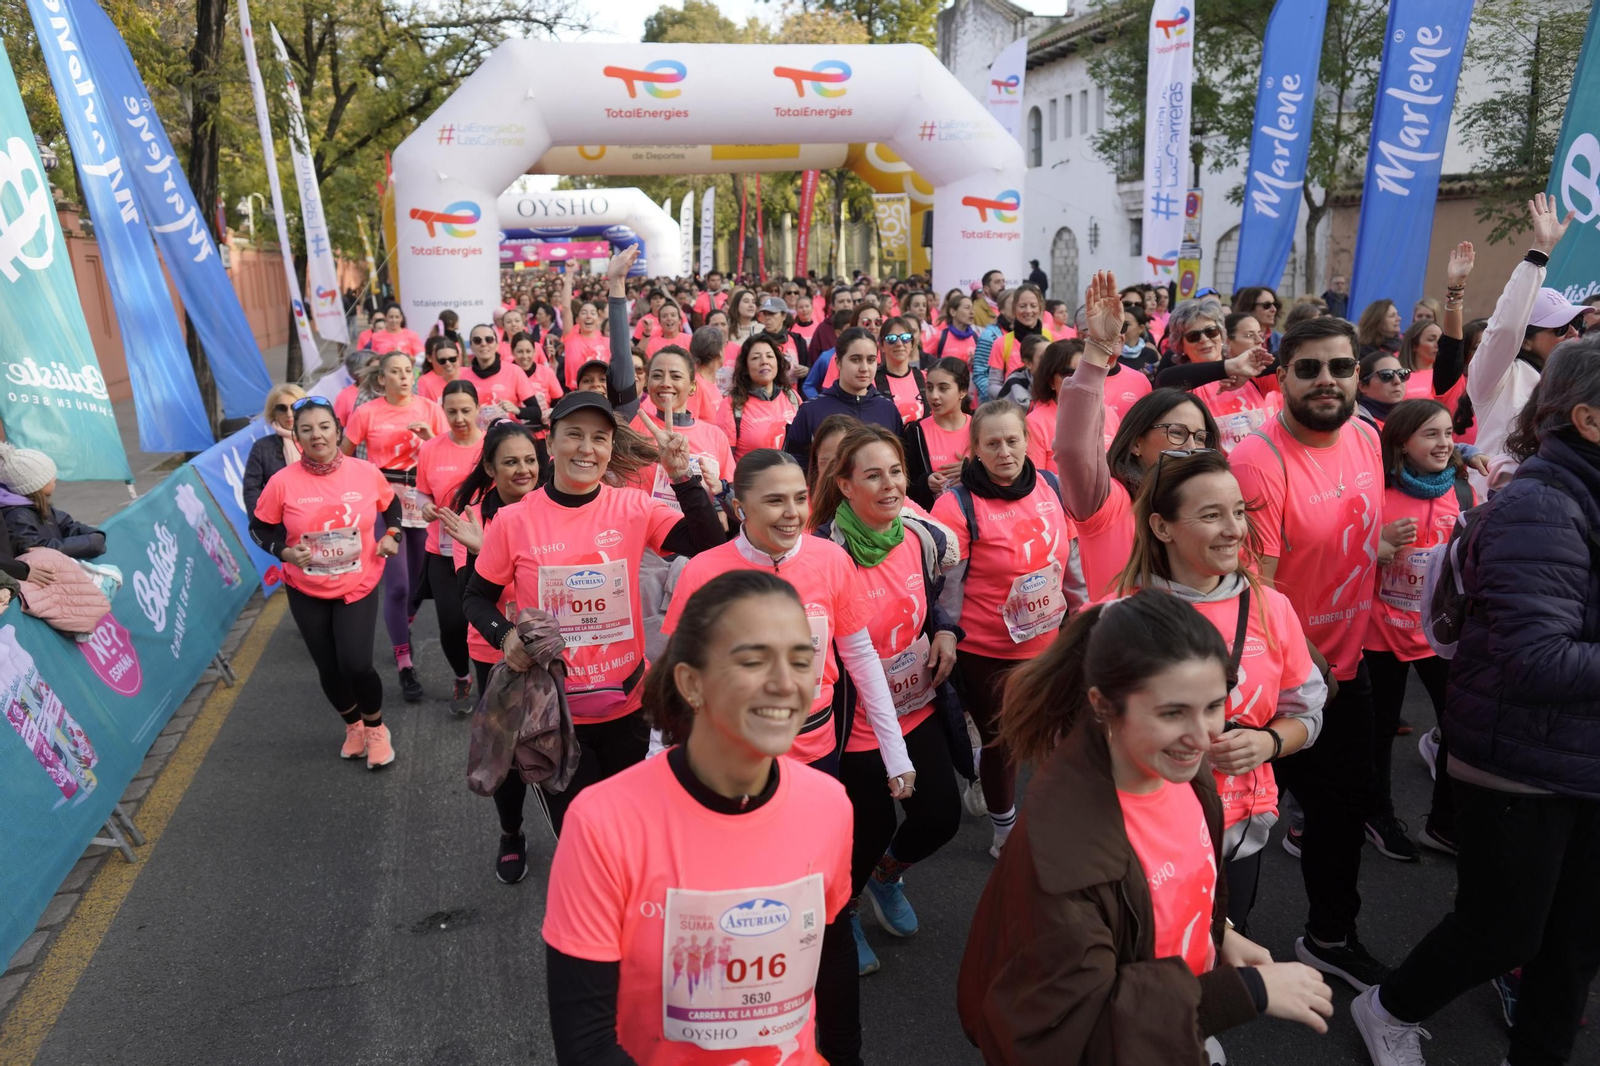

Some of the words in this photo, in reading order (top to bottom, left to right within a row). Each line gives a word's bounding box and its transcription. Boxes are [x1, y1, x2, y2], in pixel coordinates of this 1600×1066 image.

[604, 107, 689, 120] TotalEnergies
[773, 106, 853, 119] TotalEnergies
[1374, 25, 1452, 196] Marlene
[1251, 73, 1305, 218] Marlene
[645, 151, 686, 161] Deportes
[516, 197, 609, 218] OYSHO
[410, 245, 483, 258] TotalEnergies
[412, 294, 484, 307] totalenergies.es
[322, 547, 344, 558] 016
[530, 542, 565, 556] OYSHO
[133, 520, 178, 634] Batiste
[569, 578, 604, 587] ASTURIANA
[571, 598, 606, 613] 016
[1027, 595, 1050, 612] 016
[581, 616, 598, 624] 5882
[1309, 610, 1343, 626] CARRERA
[599, 631, 624, 640] Santander
[108, 653, 135, 683] ESPAÑA
[587, 663, 599, 675] DE
[600, 661, 611, 672] LA
[611, 651, 635, 670] MUJER
[590, 674, 606, 684] 2025
[893, 673, 919, 694] 016
[679, 920, 715, 931] SUMA
[725, 912, 787, 929] ASTURIANA
[726, 953, 787, 983] 016
[741, 991, 771, 1006] 3630
[688, 1010, 726, 1021] CARRERA
[727, 1009, 738, 1019] DE
[740, 1008, 751, 1018] LA
[752, 1005, 779, 1018] MUJER
[682, 1026, 738, 1041] OYSHO
